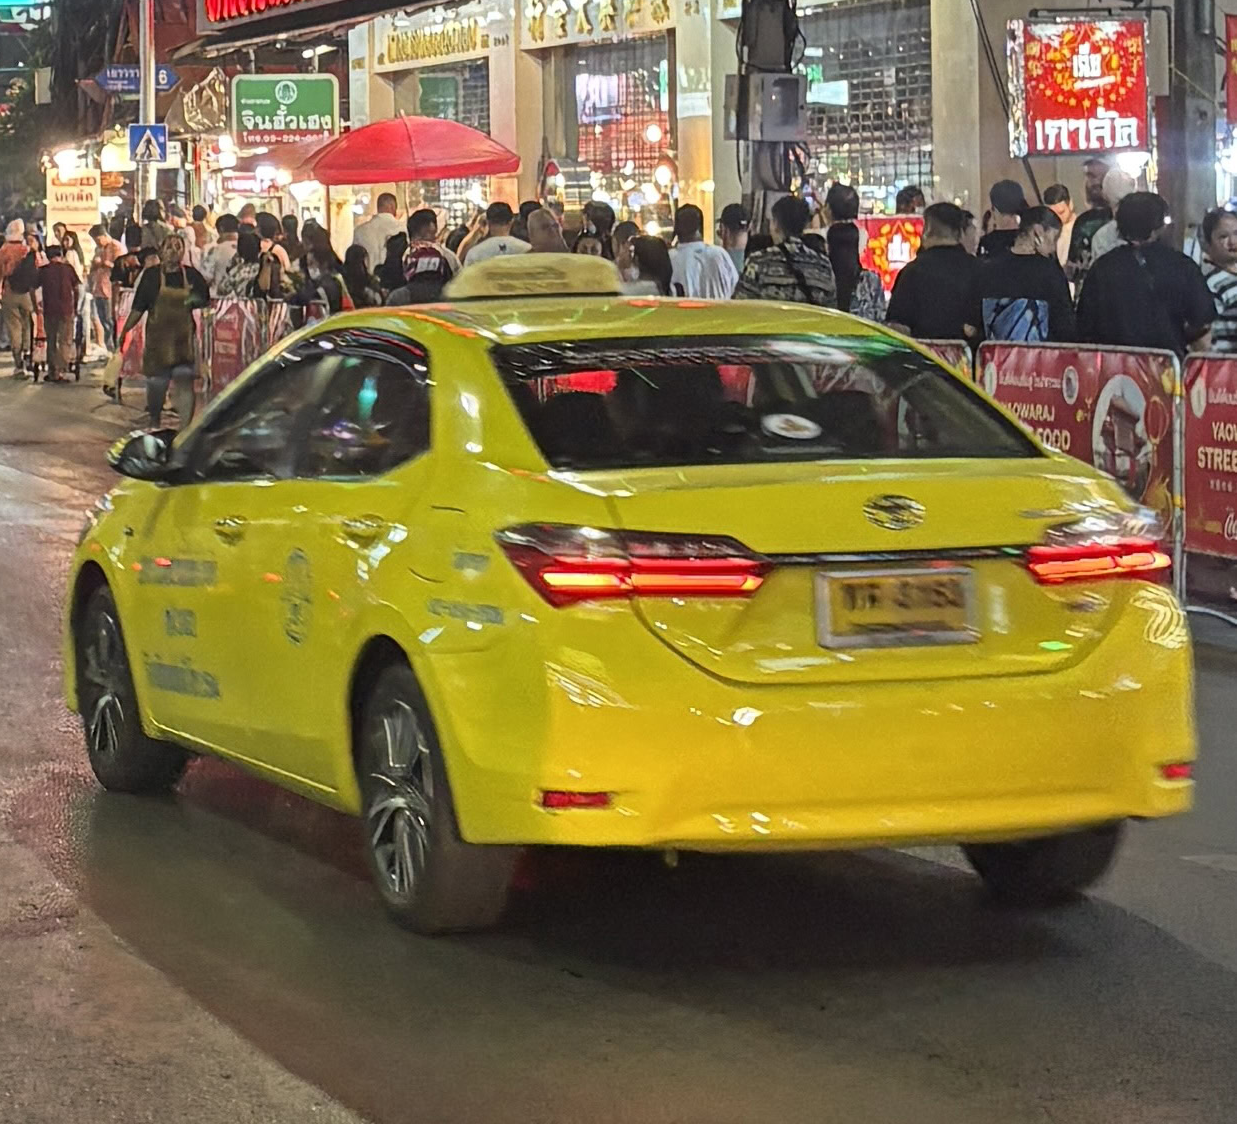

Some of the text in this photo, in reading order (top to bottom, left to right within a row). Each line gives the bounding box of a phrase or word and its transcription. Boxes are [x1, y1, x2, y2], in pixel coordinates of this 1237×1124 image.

[158, 69, 168, 85] 6
[1034, 106, 1140, 151] เกาลัด
